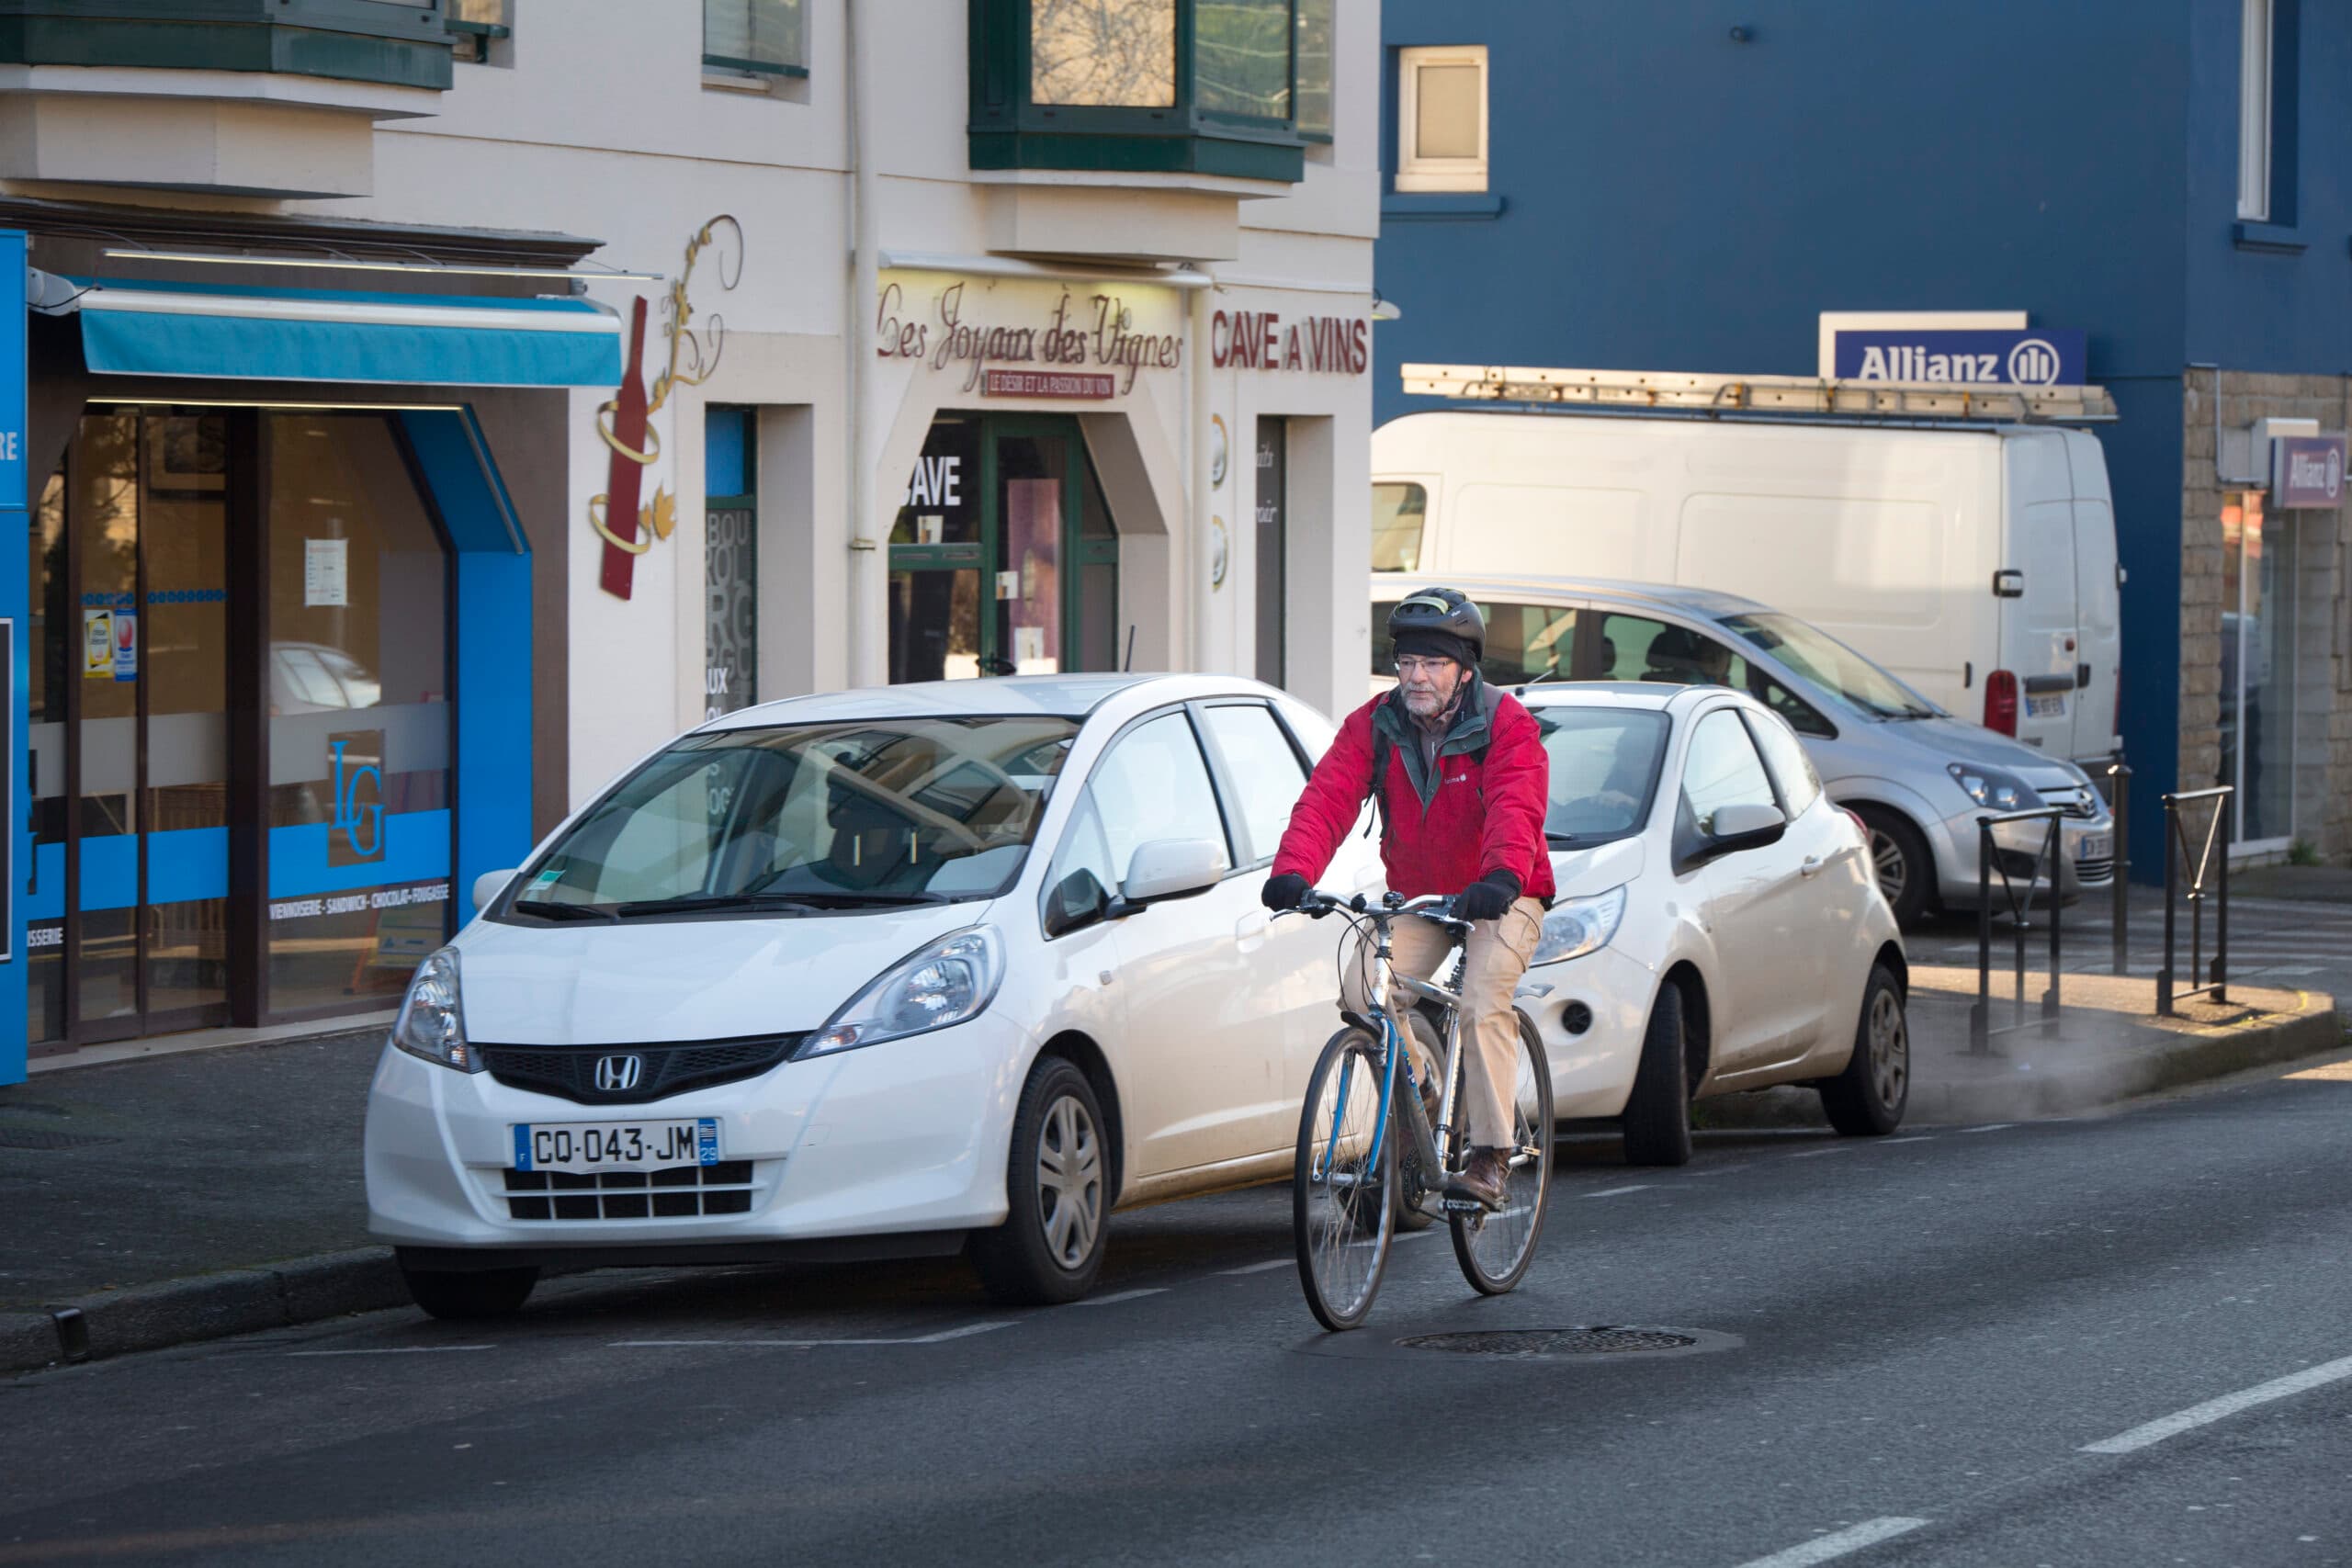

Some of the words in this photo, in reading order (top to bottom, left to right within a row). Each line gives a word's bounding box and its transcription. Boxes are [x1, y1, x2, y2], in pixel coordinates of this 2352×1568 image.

[876, 283, 927, 358] Les
[934, 280, 1037, 393] Joyaux
[1044, 292, 1088, 365] des
[1092, 293, 1183, 396] Vignes
[1212, 310, 1280, 369] CAVE
[1309, 315, 1368, 374] VINS
[1859, 345, 1999, 382] Allianz
[989, 374, 1001, 392] LE
[1036, 375, 1049, 393] LA
[2290, 453, 2325, 489] Allianz
[325, 894, 368, 915] SANDWICH
[700, 1146, 717, 1162] 29
